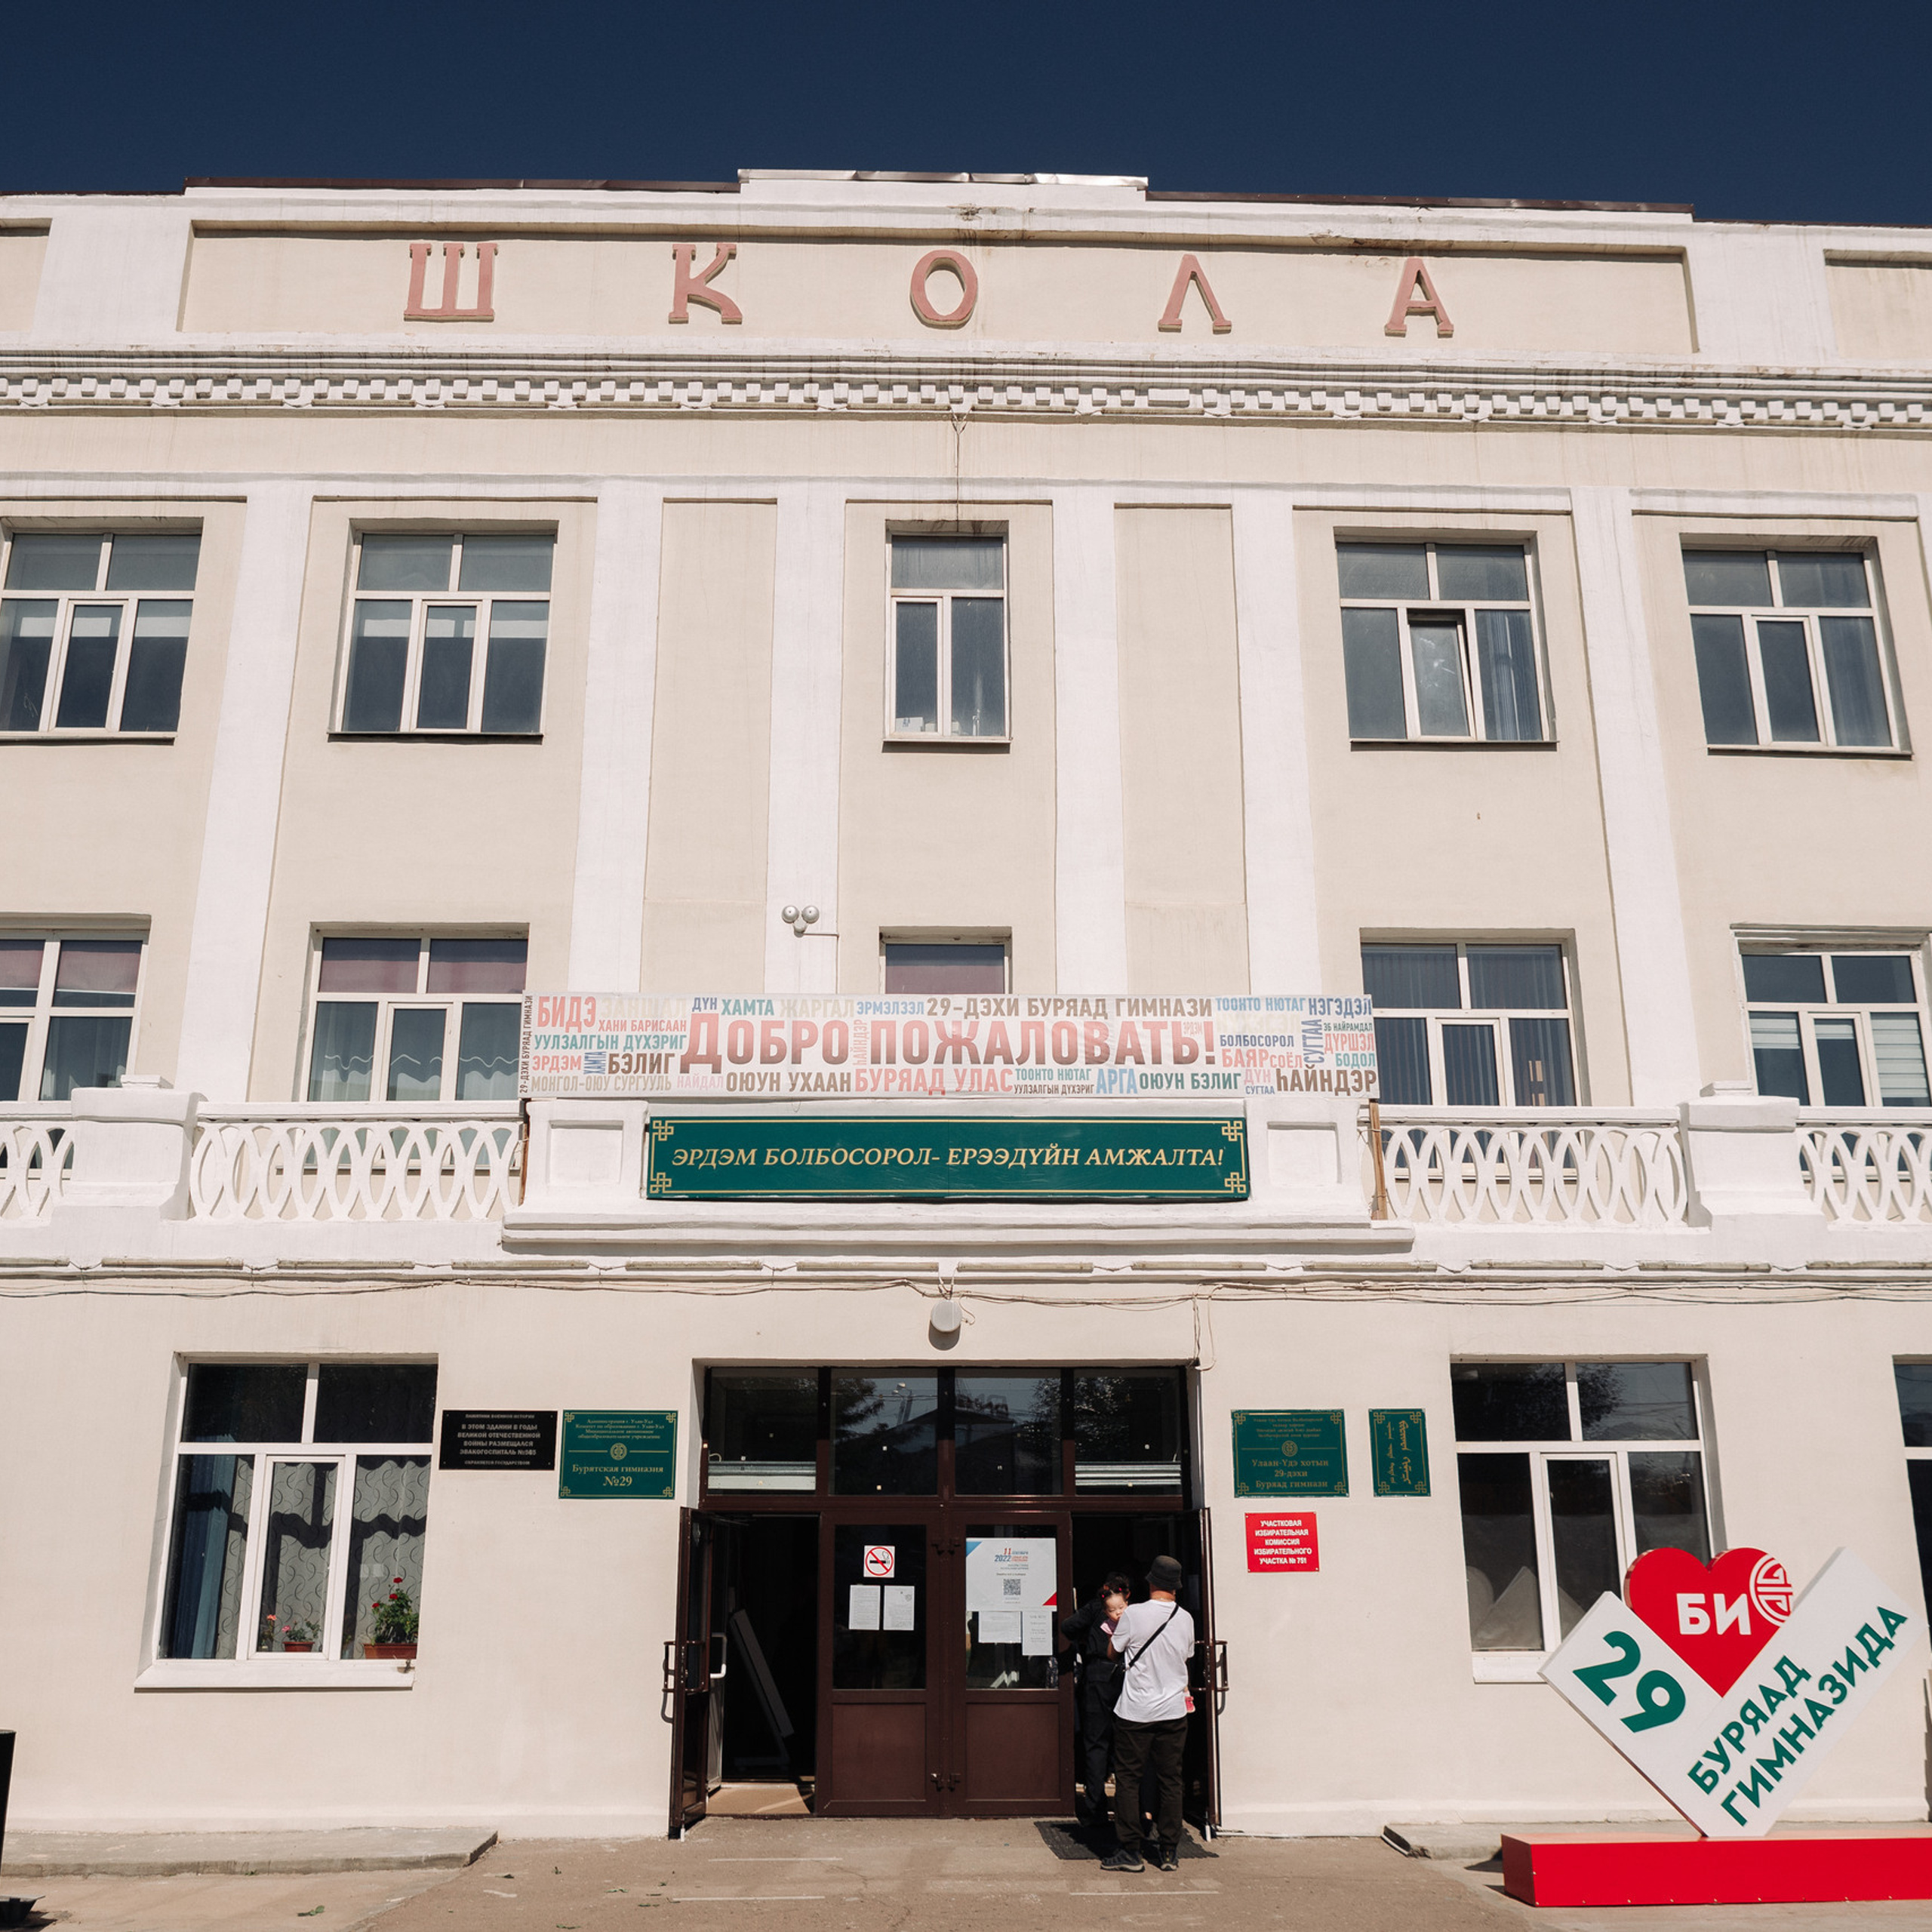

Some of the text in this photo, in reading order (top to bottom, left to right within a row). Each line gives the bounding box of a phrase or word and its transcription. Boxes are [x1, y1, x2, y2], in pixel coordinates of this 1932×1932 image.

[404, 243, 1454, 337] ШКОЛА
[721, 999, 774, 1016] ХАМТА
[780, 999, 854, 1017] ЖАРГАЛ
[857, 1001, 924, 1015] ЭРМЭЛЗЭЛ
[927, 998, 1212, 1020] 29-ДЭХИ БУРЯАД ГИМНАЗИ
[1215, 998, 1306, 1011] ТООНТО НЮТАГ
[1309, 998, 1372, 1018] НЭГЭДЭЛ
[537, 996, 596, 1033] БИДЭ
[598, 1020, 686, 1032] ХАНИ БАРИСААН
[1334, 1021, 1373, 1032] НАЙРАМДАЛ
[519, 995, 534, 1094] 29-ДЭХИ БУРЯАД ГИМНАЗИ
[534, 1035, 618, 1050] УУЛЗАЛГЫН
[679, 1013, 1215, 1074] ДОБРО ПОЖАЛОВАТЬ!
[1220, 1035, 1294, 1047] БОЛБОСОРОЛ
[1301, 1019, 1324, 1063] СУГТАА
[532, 1055, 581, 1073] ЭРДЭМ
[608, 1053, 675, 1075] БЭЛИГ
[1222, 1048, 1269, 1068] БАЯР
[1336, 1053, 1376, 1069] БОДОЛ
[614, 1075, 672, 1091] СУРГУУЛЬ
[677, 1072, 724, 1091] НАЙДАЛ
[726, 1072, 851, 1092] ОЮУН УХААН
[855, 1068, 1013, 1096] БУРЯАД УЛАС
[1015, 1069, 1092, 1081] ТООНТО НЮТАГ
[1096, 1069, 1138, 1094] АРГА
[1139, 1073, 1241, 1091] ОЮУН БЭЛИГ
[1014, 1084, 1059, 1094] УУЛЗАЛГЫН
[1245, 1085, 1275, 1094] СУГТАА
[672, 1148, 758, 1169] ЭРДЭМ
[1084, 1148, 1224, 1166] АМЖАЛТА!
[572, 1464, 619, 1474] Бурятская
[603, 1476, 632, 1486] №29
[1256, 1481, 1287, 1489] Буряад
[1675, 1592, 1752, 1635] БИ
[1572, 1630, 1686, 1734] 29
[1687, 1654, 1811, 1795] БУРЯАД
[1721, 1605, 1908, 1827] ГИМНАЗИДА
